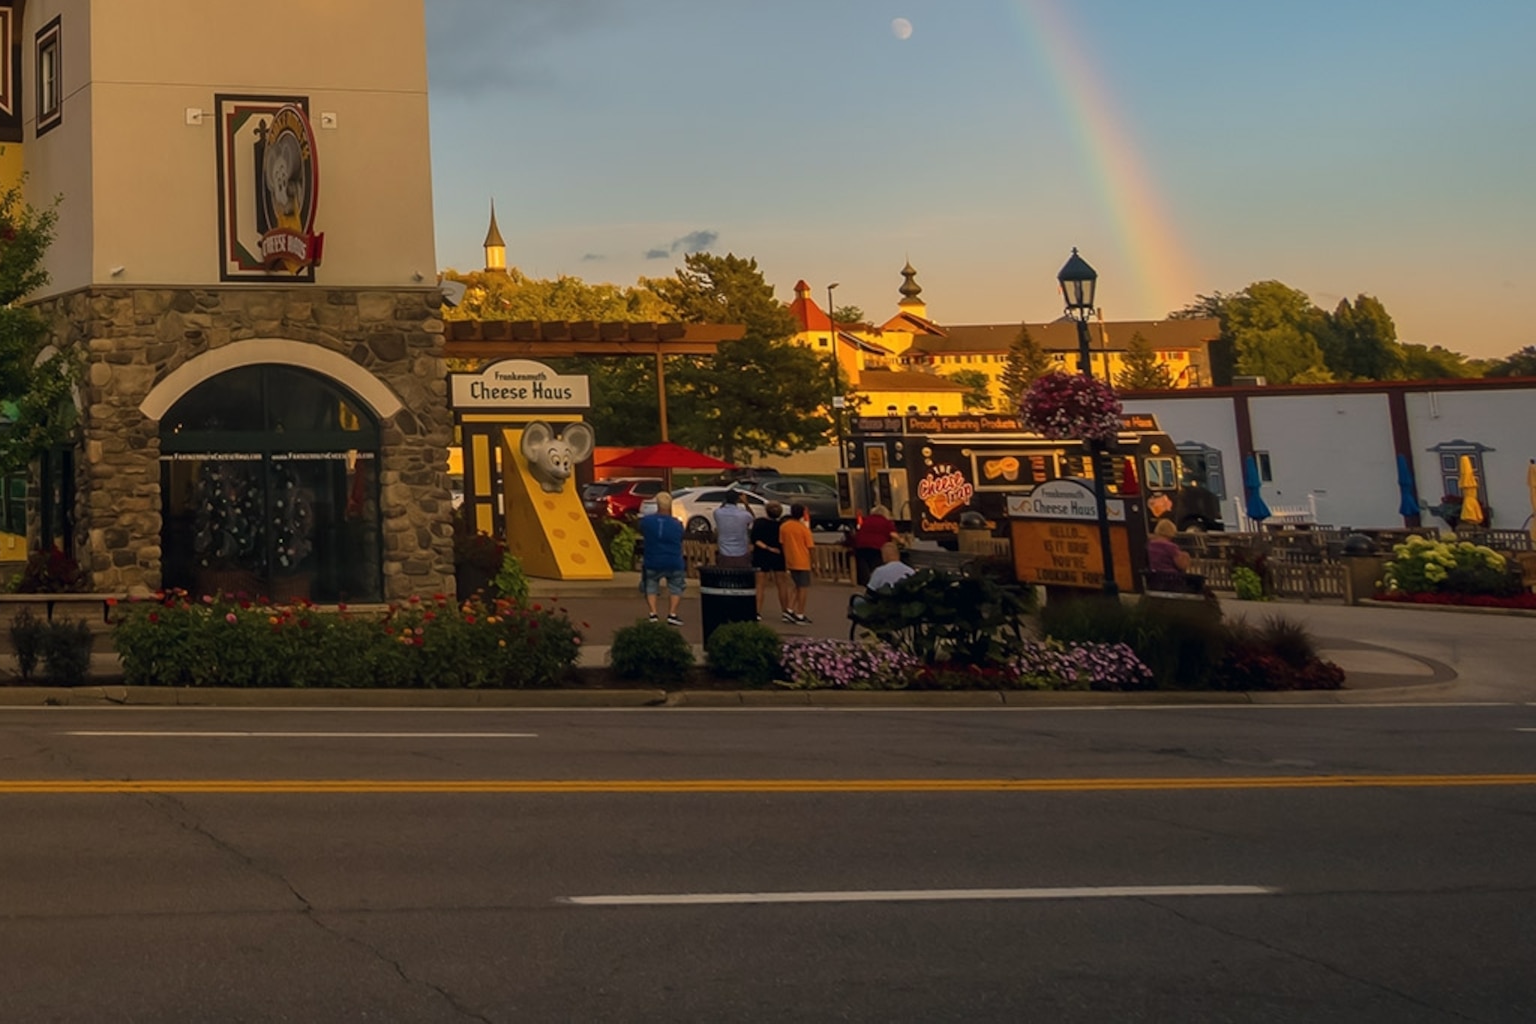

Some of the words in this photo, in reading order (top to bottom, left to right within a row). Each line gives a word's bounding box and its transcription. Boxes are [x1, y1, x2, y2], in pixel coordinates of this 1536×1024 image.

[494, 371, 547, 382] Frankenmuth
[470, 381, 527, 400] Cheese
[532, 381, 572, 400] Haus
[918, 470, 965, 500] Cheese
[947, 483, 973, 506] Trap
[1033, 499, 1068, 515] Cheese
[1070, 501, 1096, 516] Haus
